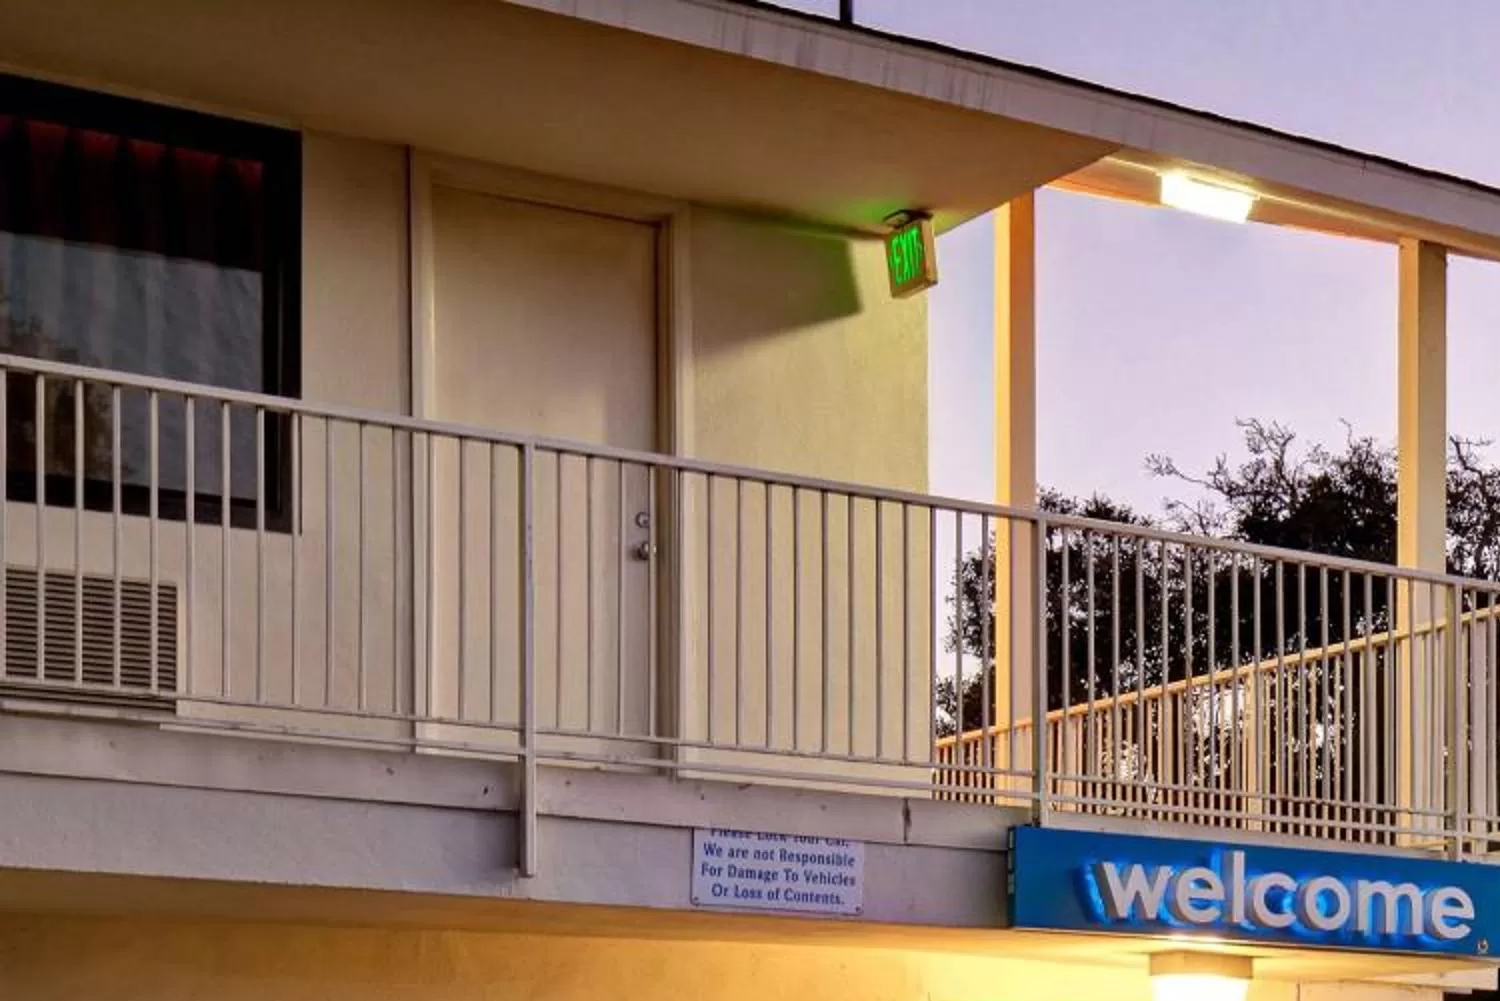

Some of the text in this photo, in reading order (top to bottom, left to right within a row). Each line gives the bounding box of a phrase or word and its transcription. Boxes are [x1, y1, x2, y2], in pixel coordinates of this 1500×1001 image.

[703, 842, 856, 868] We are not Responsible
[701, 863, 856, 887] For Damage To Vehicles
[711, 883, 845, 906] Or Loss of Contents.
[1098, 849, 1477, 941] welcome
